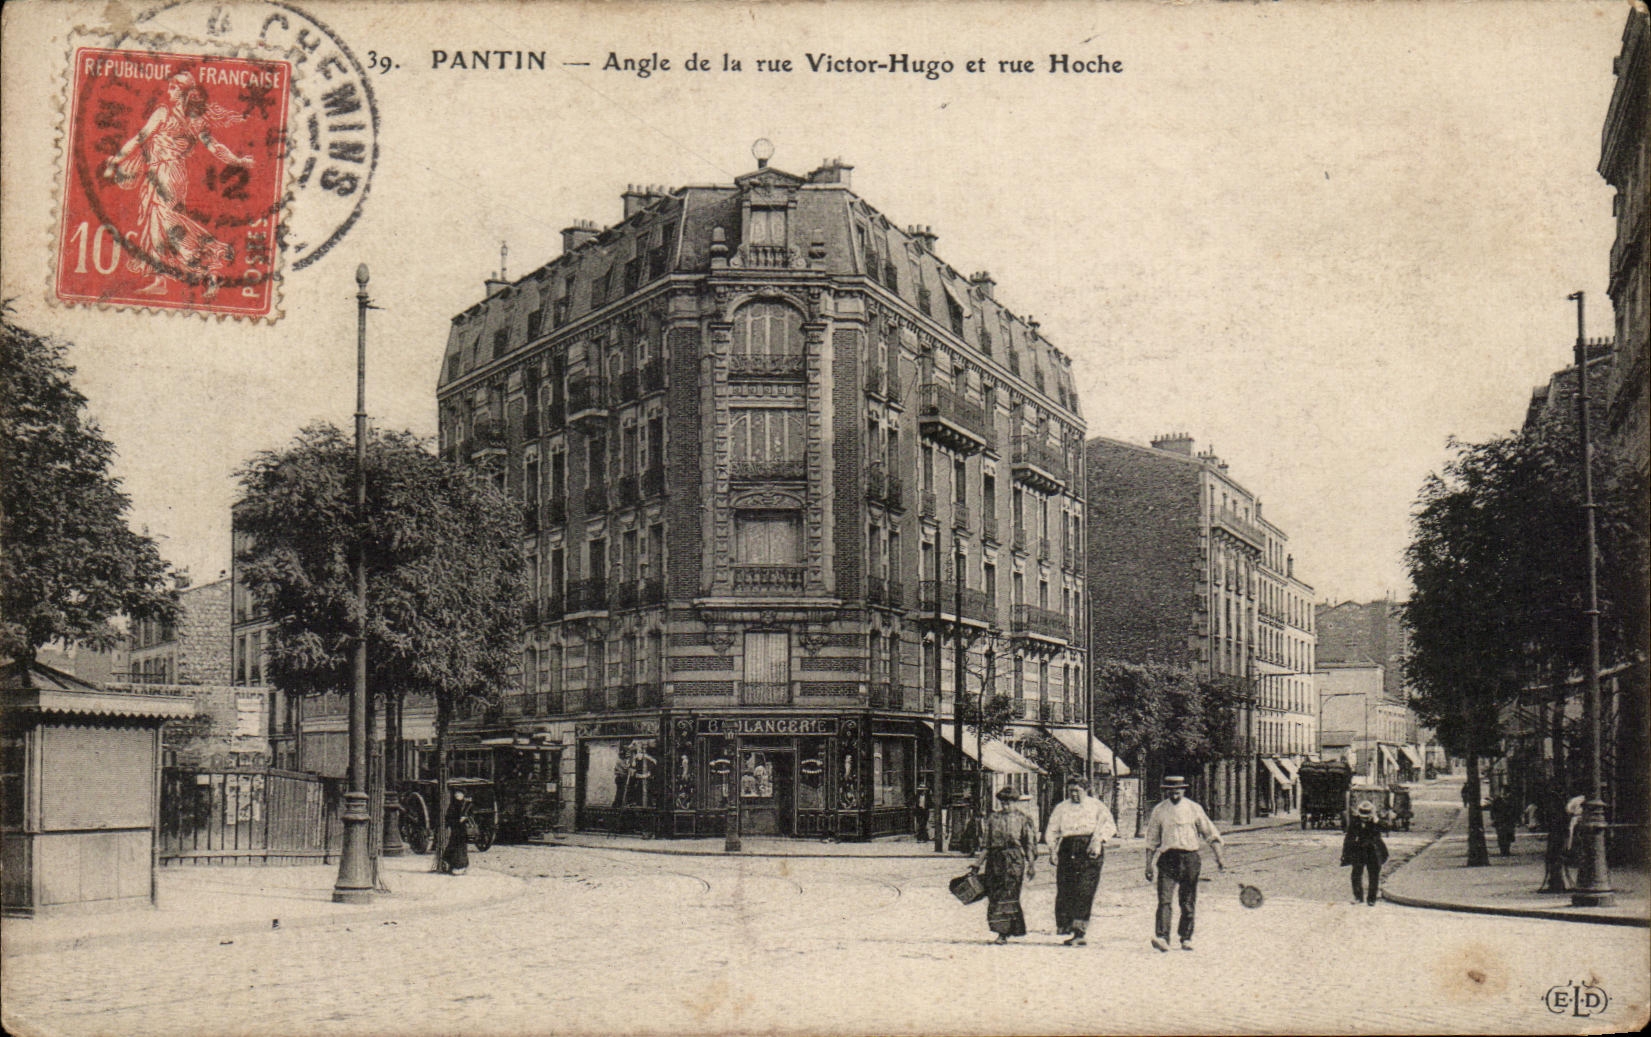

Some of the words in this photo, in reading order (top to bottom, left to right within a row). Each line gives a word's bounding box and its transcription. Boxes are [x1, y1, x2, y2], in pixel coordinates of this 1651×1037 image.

[200, 66, 281, 90] FRANÇAISE
[258, 12, 366, 197] CHEMINS
[70, 221, 121, 275] 10
[708, 719, 828, 733] BLANGERIE
